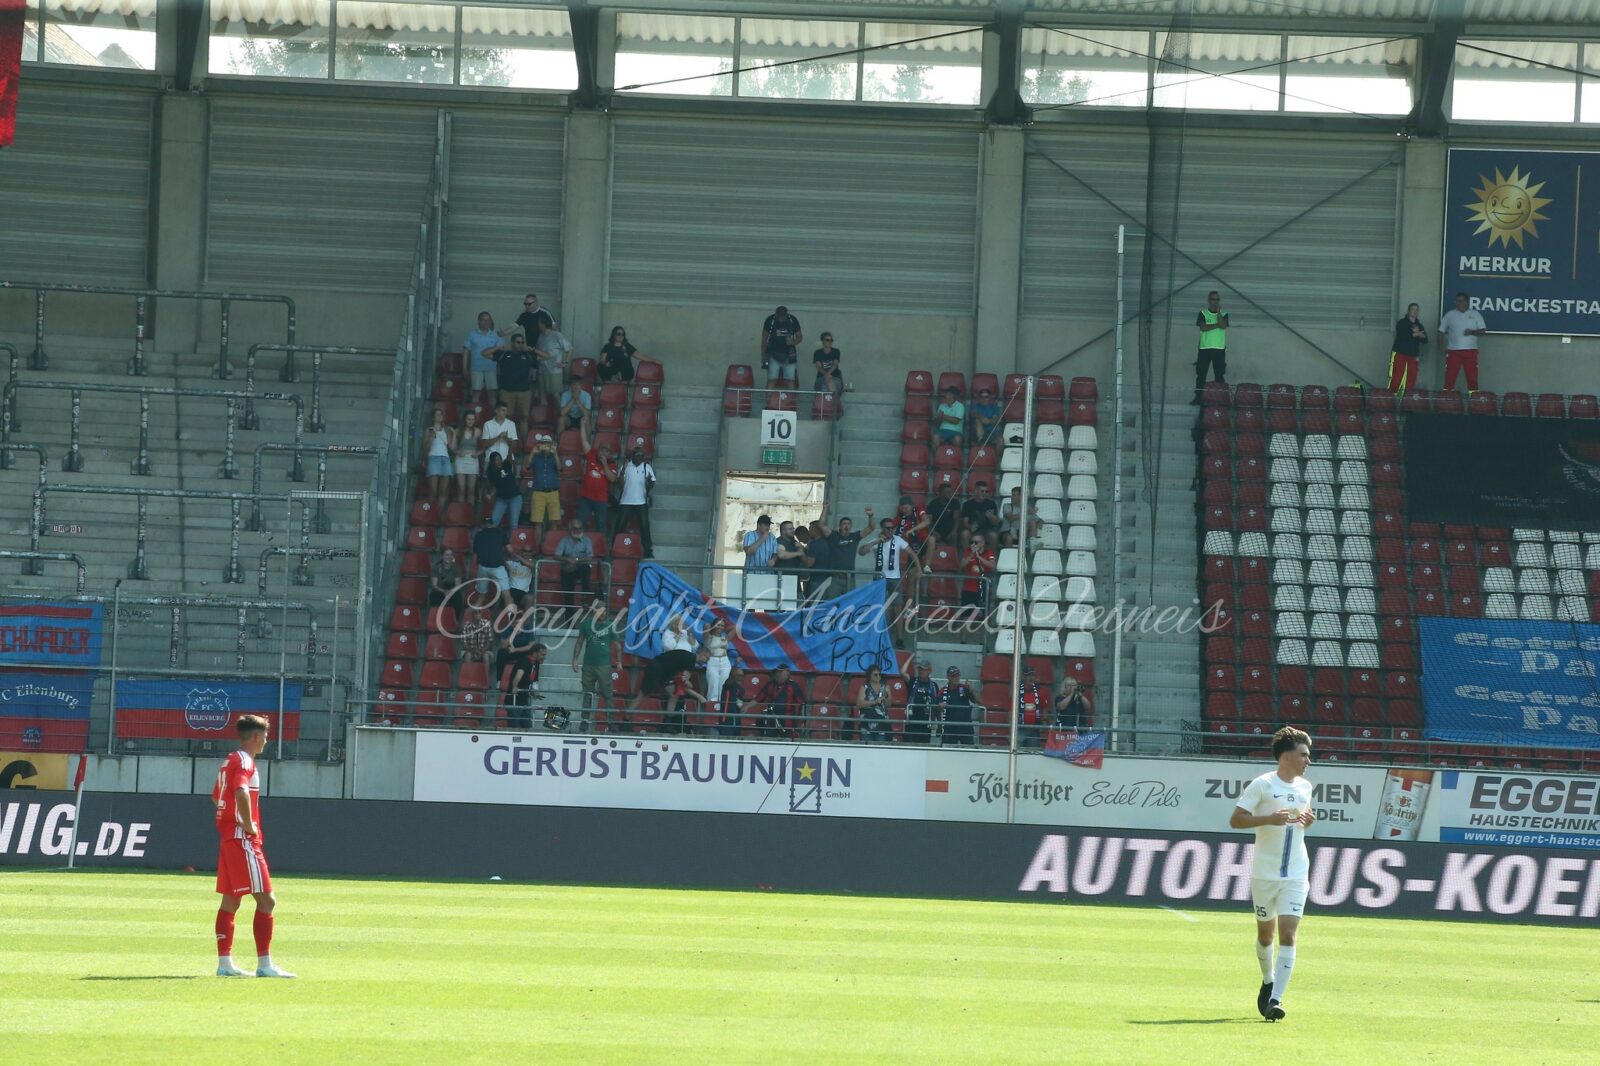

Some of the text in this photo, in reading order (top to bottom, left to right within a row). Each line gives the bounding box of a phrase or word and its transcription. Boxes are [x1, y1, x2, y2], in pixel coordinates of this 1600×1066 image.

[1459, 256, 1552, 274] MERKUR
[1469, 297, 1600, 315] RANCKESTRA
[767, 418, 792, 439] 10
[16, 684, 80, 710] Eilenburg
[825, 791, 852, 799] GmbH
[1082, 781, 1136, 808] Edel
[1131, 780, 1182, 808] Pils
[1470, 814, 1598, 831] HAUSTECHNIK
[1018, 835, 1600, 918] AUTOHUS-KOE
